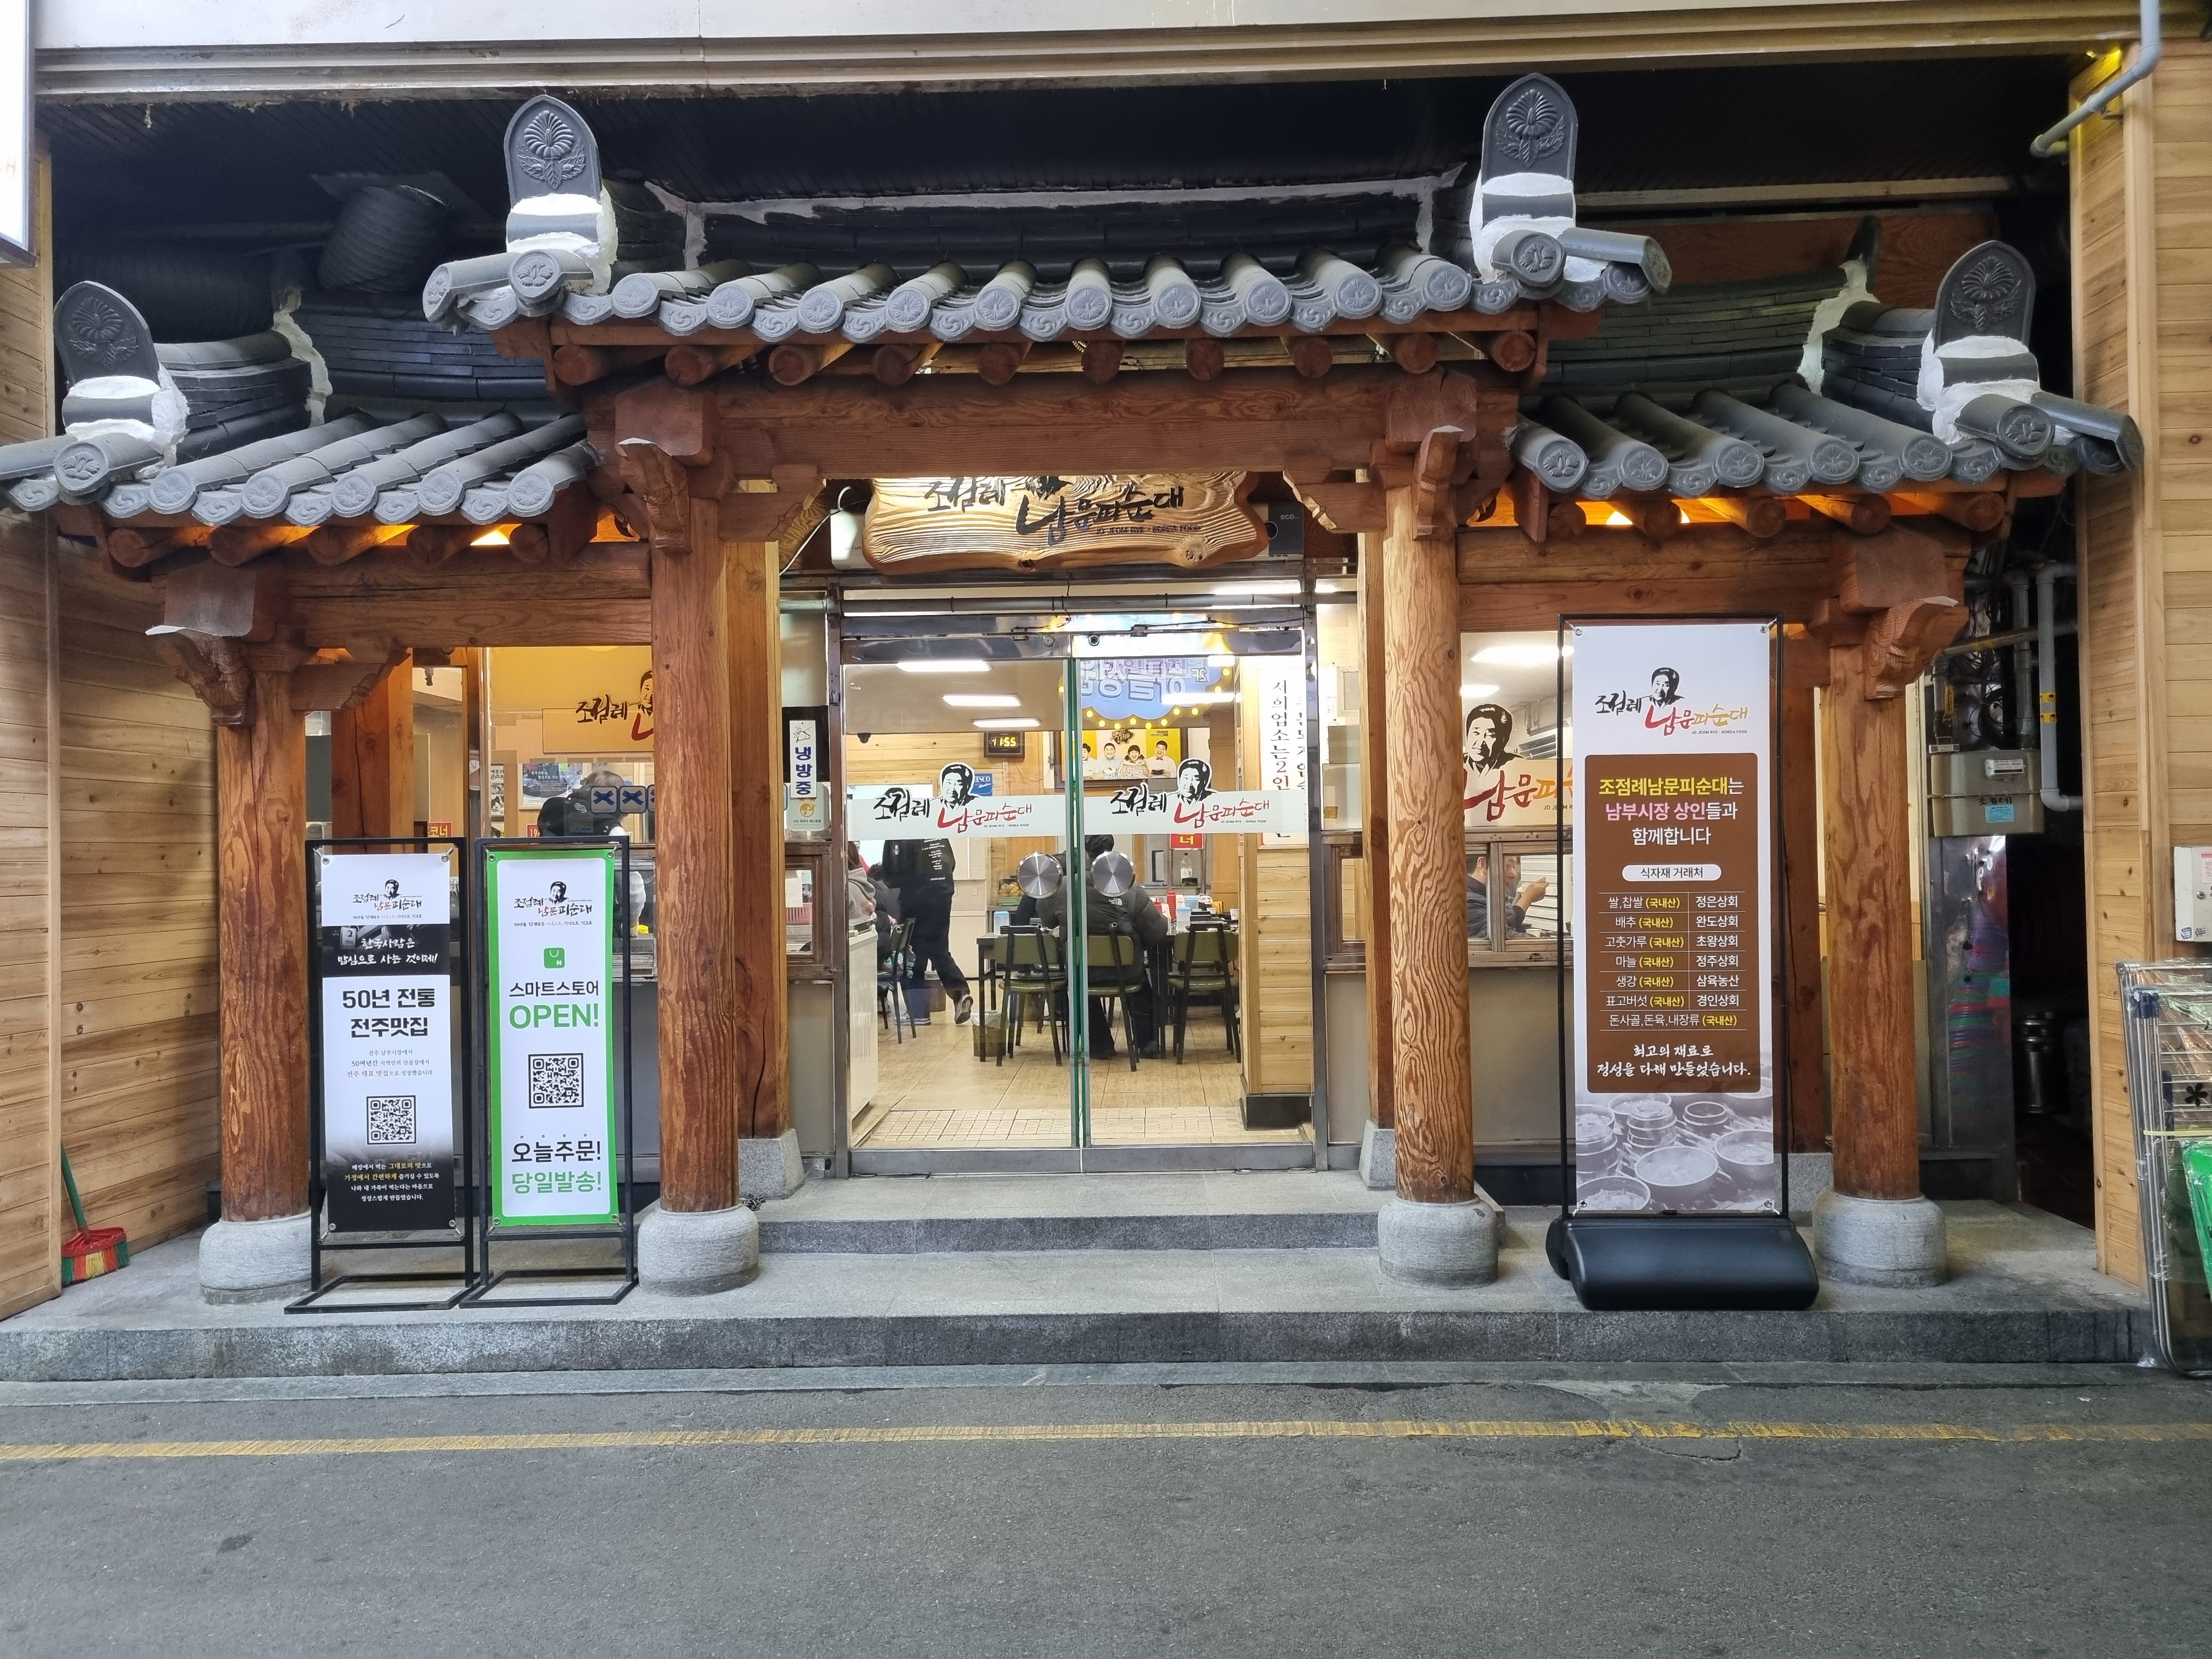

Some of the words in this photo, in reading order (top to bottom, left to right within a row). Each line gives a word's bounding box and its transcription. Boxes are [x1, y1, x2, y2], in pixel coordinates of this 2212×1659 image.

[924, 476, 1006, 513] 조점례
[575, 694, 628, 724] 조점례
[1595, 690, 1643, 715] 조점례
[1645, 703, 1748, 736] 남문피순대
[794, 746, 813, 795] 냉방중
[1598, 776, 1744, 796] 조점례남문피순대는
[873, 787, 930, 822] 조점례
[937, 802, 1032, 834] 남문피순대
[1109, 784, 1167, 816] 조점례
[1173, 798, 1269, 829] 남문피순대
[1605, 802, 1670, 821] 남부시장
[1673, 802, 1738, 821] 상인들과
[1632, 826, 1712, 845] 함께합니다
[1640, 867, 1671, 878] 식자재
[1673, 867, 1703, 878] 거래처
[352, 893, 379, 904] 조점례
[374, 899, 422, 910] 남문피순대
[514, 896, 544, 909] 조점례
[538, 904, 592, 917] 남문피순대
[1608, 896, 1644, 909] 쌀,찹쌀
[1645, 896, 1680, 909] (국내산)
[1695, 895, 1739, 908] 정은상회
[1615, 916, 1637, 929] 배추
[1639, 916, 1674, 929] (국내산)
[1696, 915, 1739, 928] 완도상회
[360, 937, 415, 949] 한국사람은
[1605, 936, 1647, 948] 고춧가루
[1649, 936, 1684, 949] (국내산)
[1696, 935, 1739, 948] 초왕상회
[337, 953, 377, 966] 밥심으로
[381, 953, 402, 964] 사는
[1616, 956, 1637, 968] 마늘
[1639, 956, 1674, 968] (국내산)
[1696, 955, 1739, 967] 정주상회
[1616, 975, 1637, 988] 생강
[1639, 976, 1674, 988] (국내산)
[1696, 974, 1739, 987] 삼육농산
[509, 980, 599, 997] 스마트스토어
[342, 989, 391, 1009] 50년
[397, 988, 436, 1008] 전통
[1605, 995, 1647, 1007] 표고버섯
[1650, 996, 1685, 1008] (국내산)
[1696, 994, 1739, 1007] 경인상회
[509, 1003, 599, 1029] OPEN!
[1609, 1014, 1700, 1026] 돈사골,돈육,내장류
[1702, 1014, 1737, 1026] (국내산)
[350, 1017, 428, 1038] 전주맛집
[1633, 1043, 1670, 1058] 최고의
[1673, 1044, 1714, 1057] 재료로
[1597, 1062, 1636, 1077] 정성을
[1639, 1062, 1667, 1076] 다해
[1669, 1061, 1752, 1077] 만들었습니다.
[511, 1139, 602, 1163] 오늘주문!
[345, 1173, 370, 1182] 가정에서
[511, 1170, 602, 1195] 당일발송!
